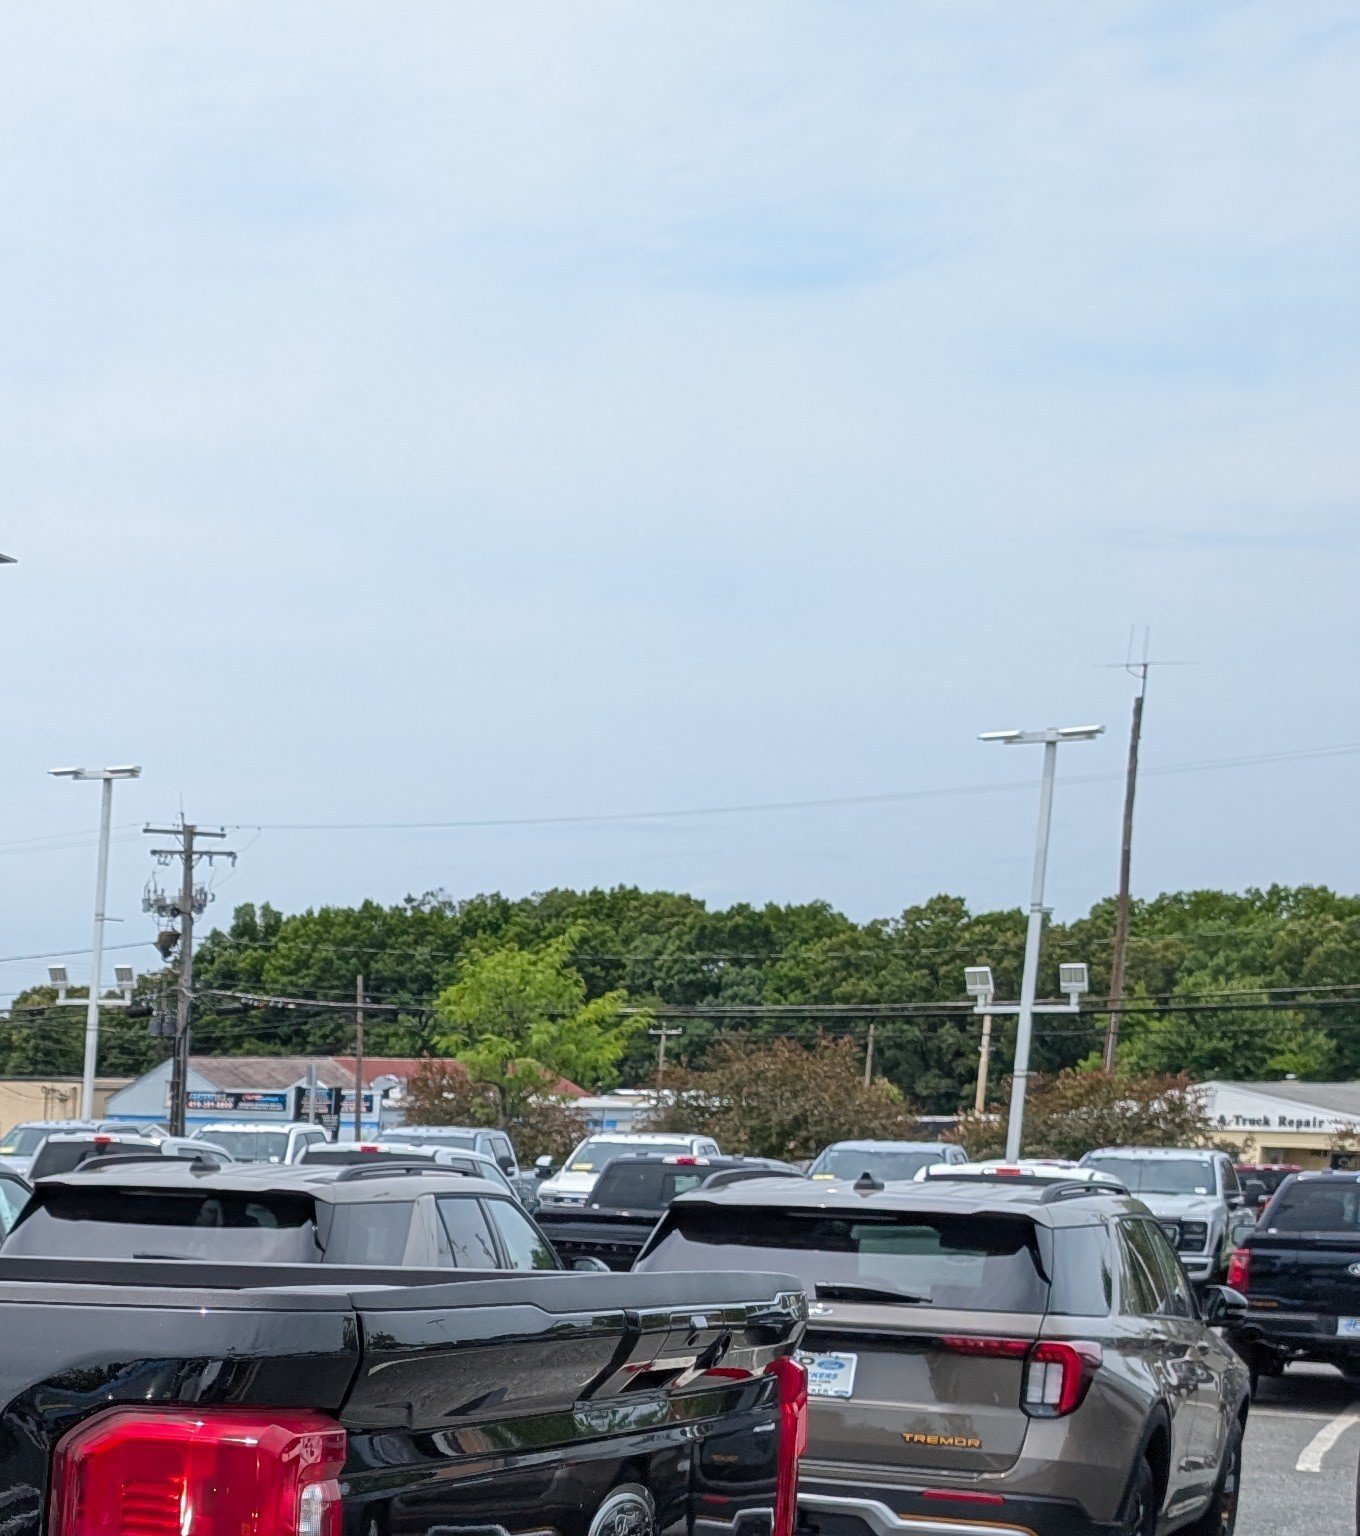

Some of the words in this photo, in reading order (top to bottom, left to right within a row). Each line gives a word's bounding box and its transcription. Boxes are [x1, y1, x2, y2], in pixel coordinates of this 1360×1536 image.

[1233, 1114, 1271, 1127] Truck
[1278, 1115, 1325, 1130] Repair
[902, 1432, 982, 1449] TREMOR
